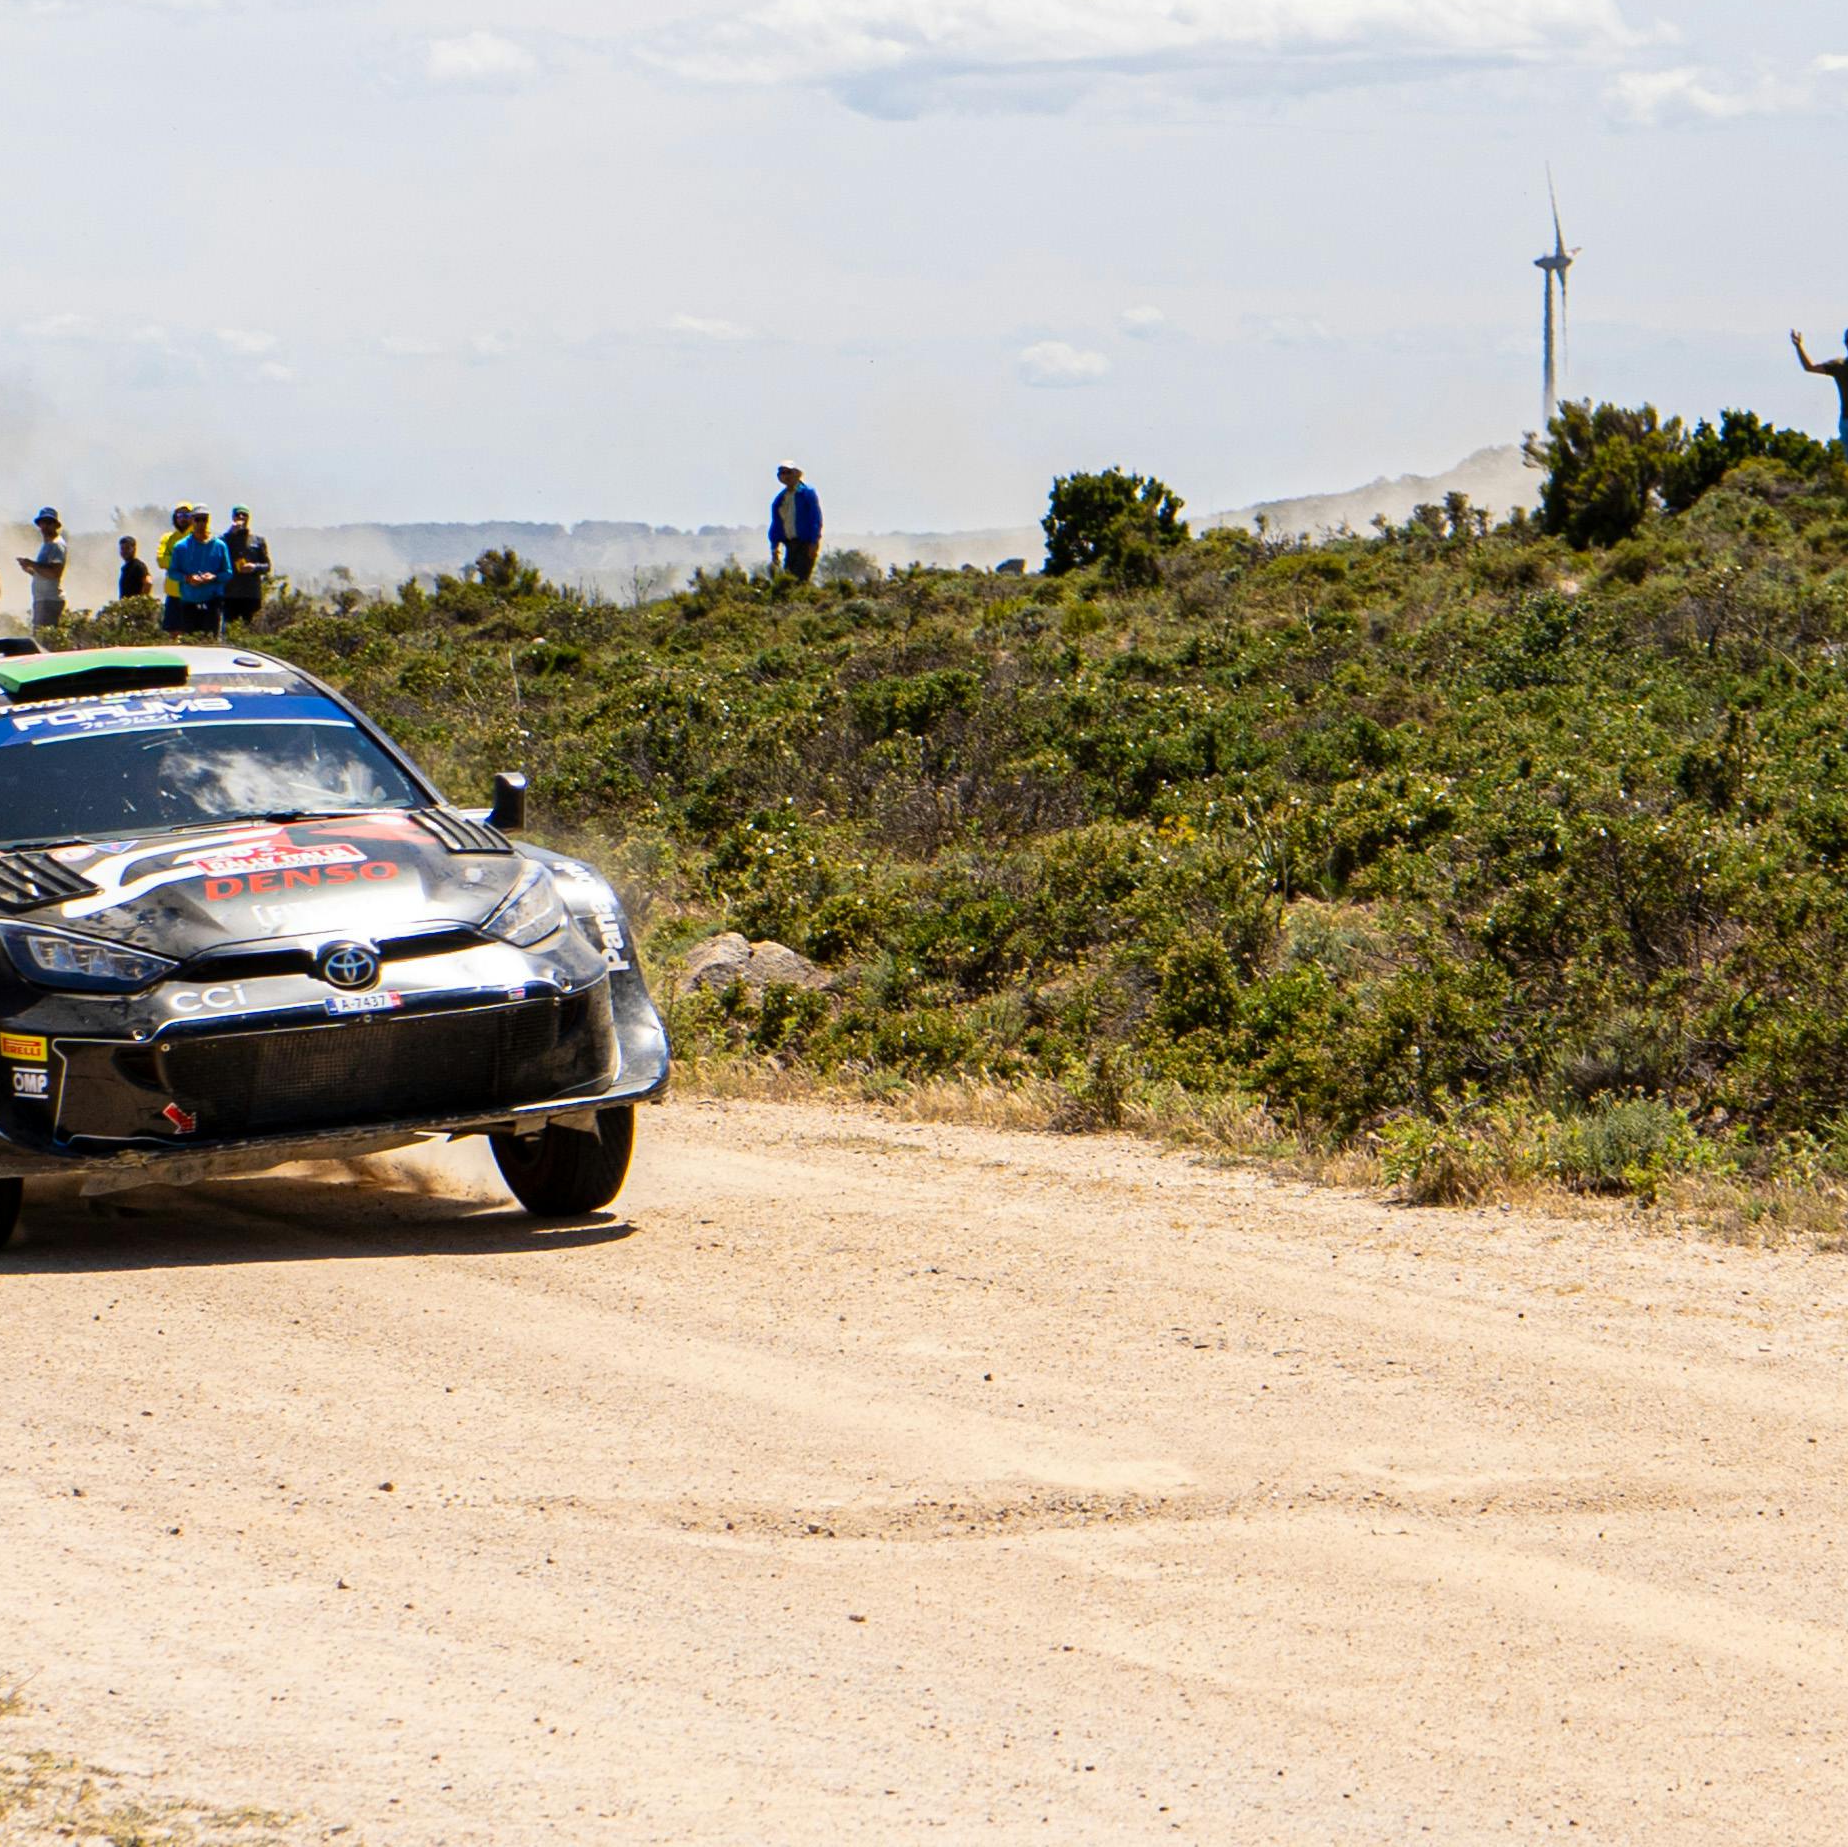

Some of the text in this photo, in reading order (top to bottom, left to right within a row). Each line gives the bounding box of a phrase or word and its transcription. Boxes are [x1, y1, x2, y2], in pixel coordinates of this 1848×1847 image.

[197, 684, 285, 696] Racing
[13, 698, 233, 731] FORUM8
[205, 862, 399, 902] DENSO
[3, 1038, 42, 1057] PIRELLI
[12, 1072, 49, 1093] OMP
